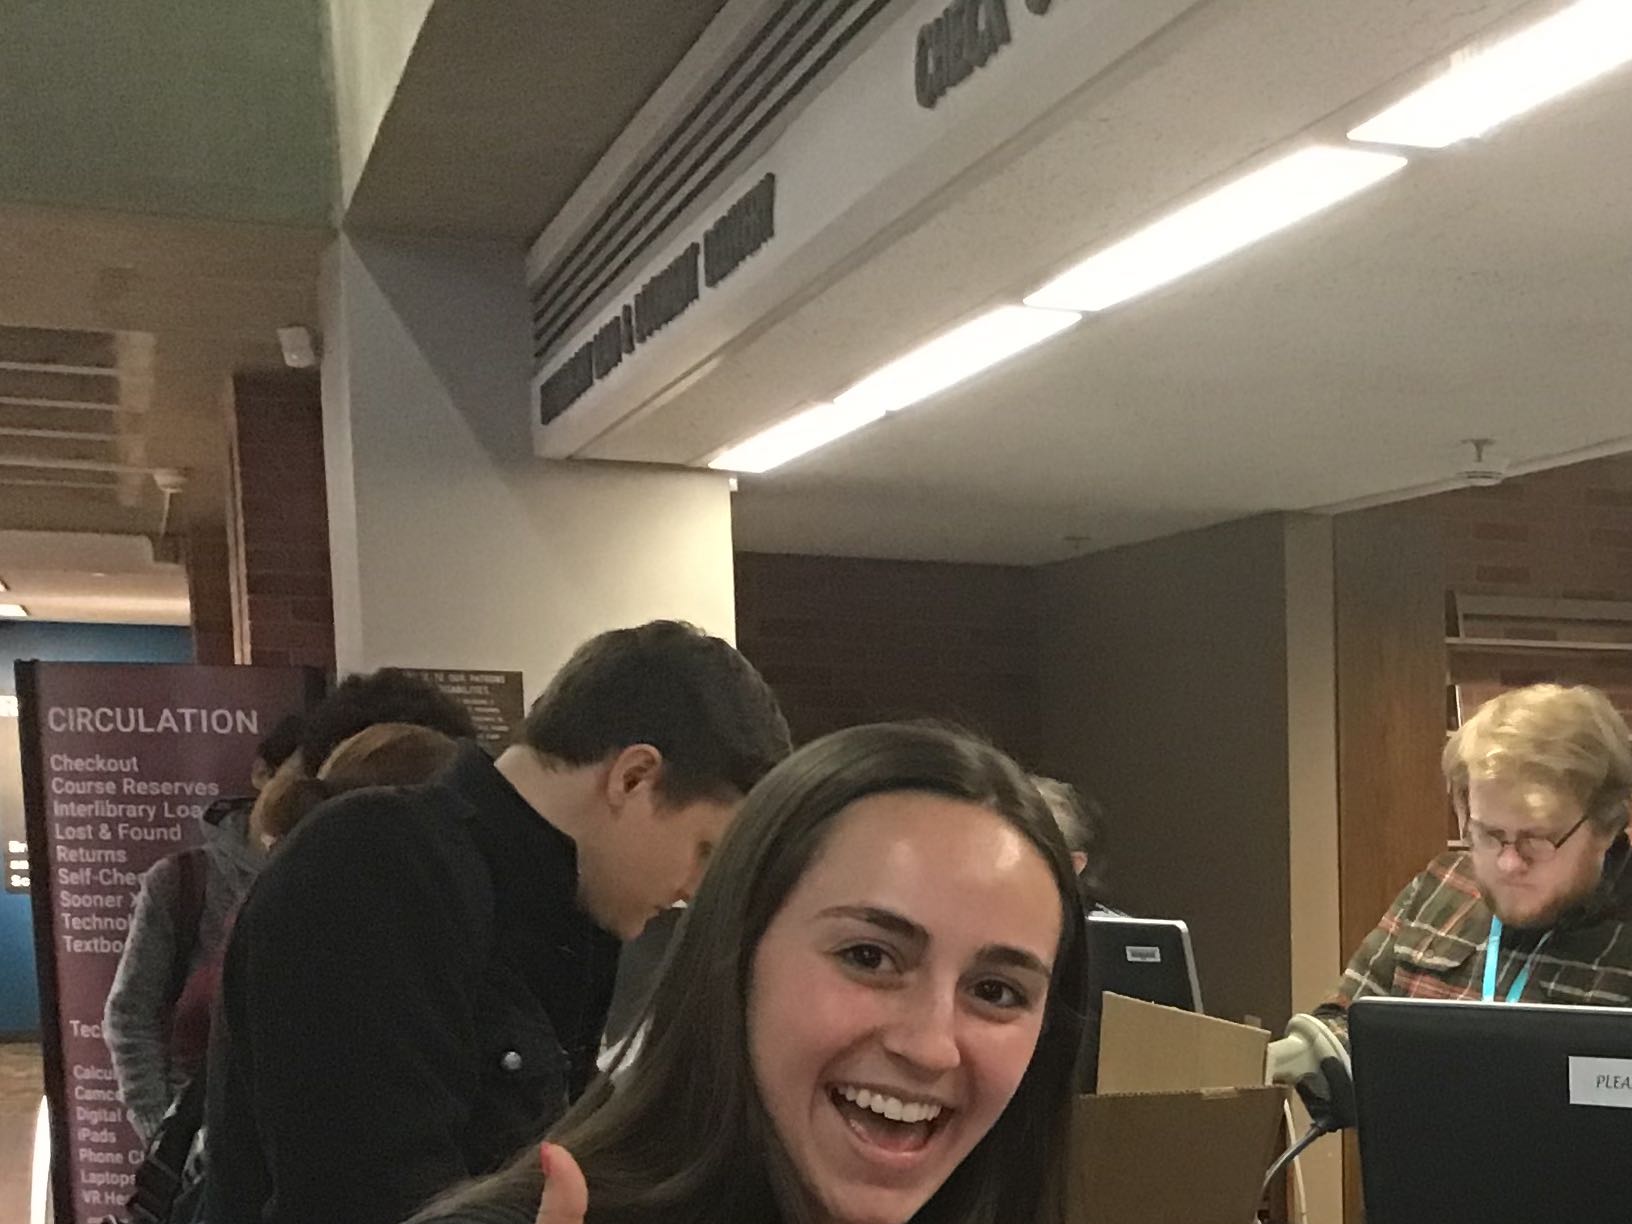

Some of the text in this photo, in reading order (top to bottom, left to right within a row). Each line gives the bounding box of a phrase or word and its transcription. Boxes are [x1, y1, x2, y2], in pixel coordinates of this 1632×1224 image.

[48, 706, 259, 734] CIRCULATION
[50, 753, 140, 772] Checkout
[51, 777, 220, 796] Course Reserves
[53, 800, 203, 821] Interlibrary Loa
[54, 823, 182, 841] Lost & Found
[56, 845, 128, 863] Returns
[59, 890, 124, 908] Sooner
[79, 1148, 124, 1164] Phone
